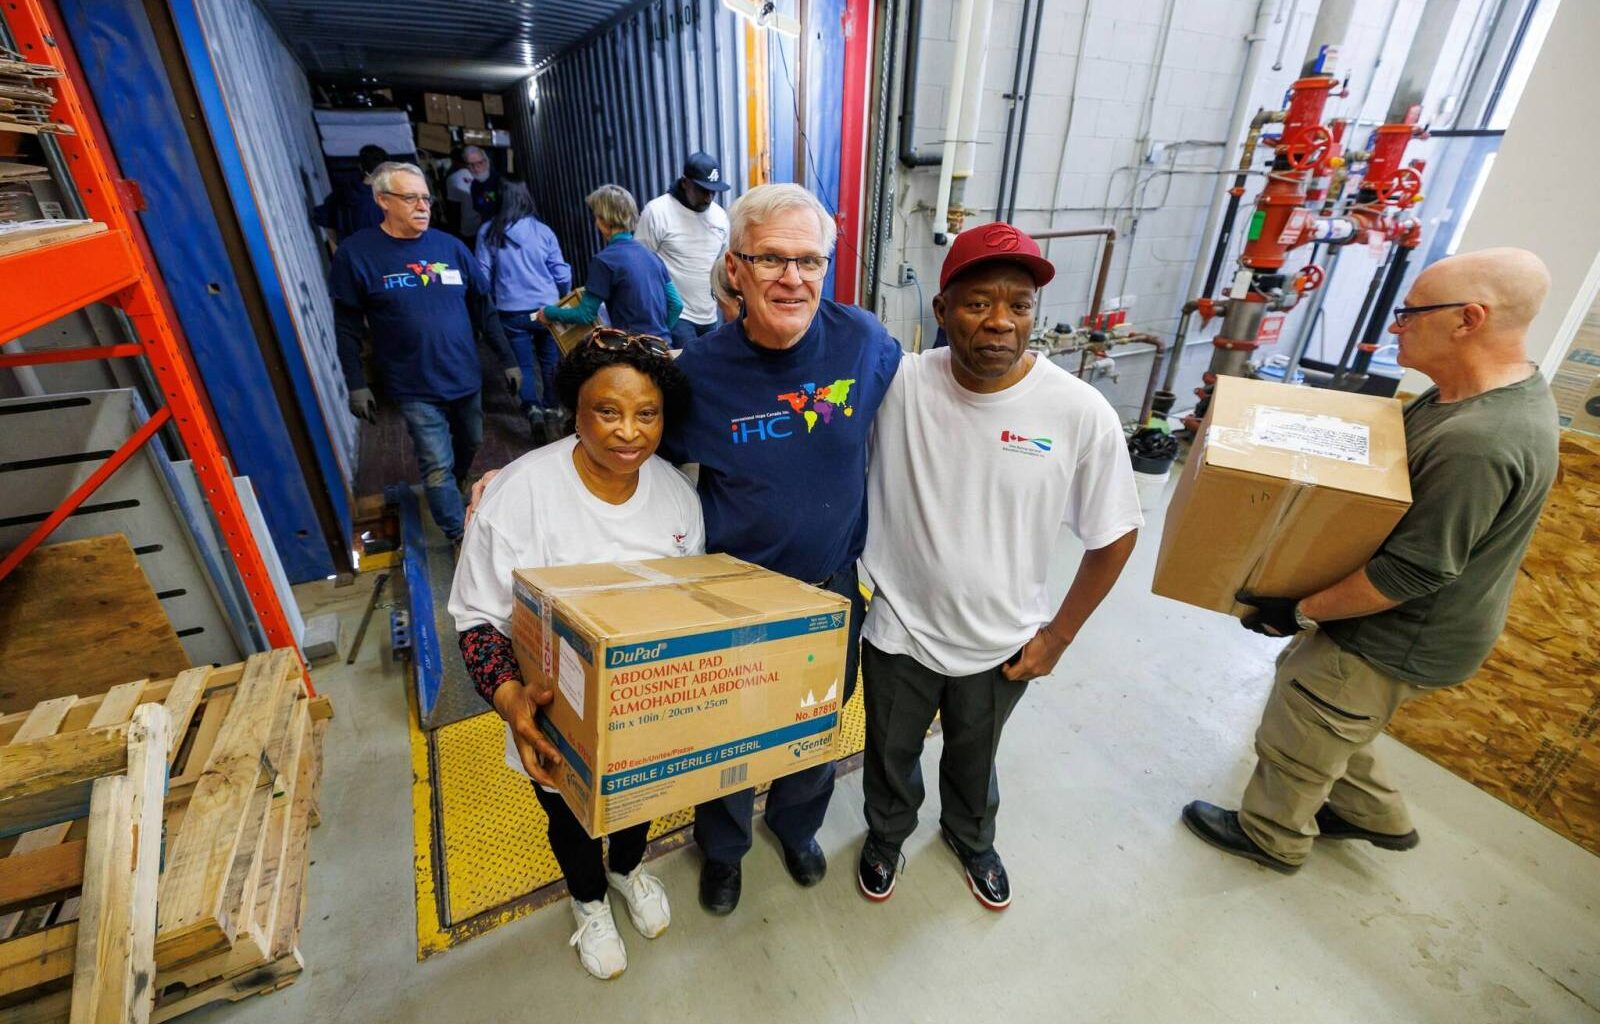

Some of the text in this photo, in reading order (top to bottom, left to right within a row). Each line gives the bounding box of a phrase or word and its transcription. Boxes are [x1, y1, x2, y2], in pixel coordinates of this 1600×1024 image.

[731, 416, 793, 444] iHC
[610, 655, 723, 687] ABDOMINAL PAD
[610, 661, 765, 702] COUSSINET ABDOMINAL
[609, 671, 780, 718] ALMOHADILLA ABDOMINAL
[607, 720, 626, 732] 8in
[628, 719, 635, 727] x
[638, 712, 660, 725] 10in
[668, 705, 694, 718] 20cm
[703, 698, 729, 711] 25cm
[606, 768, 658, 791] STERILE
[666, 753, 713, 774] STÉRILE
[720, 740, 762, 759] ESTÉRIL
[606, 759, 628, 773] 200
